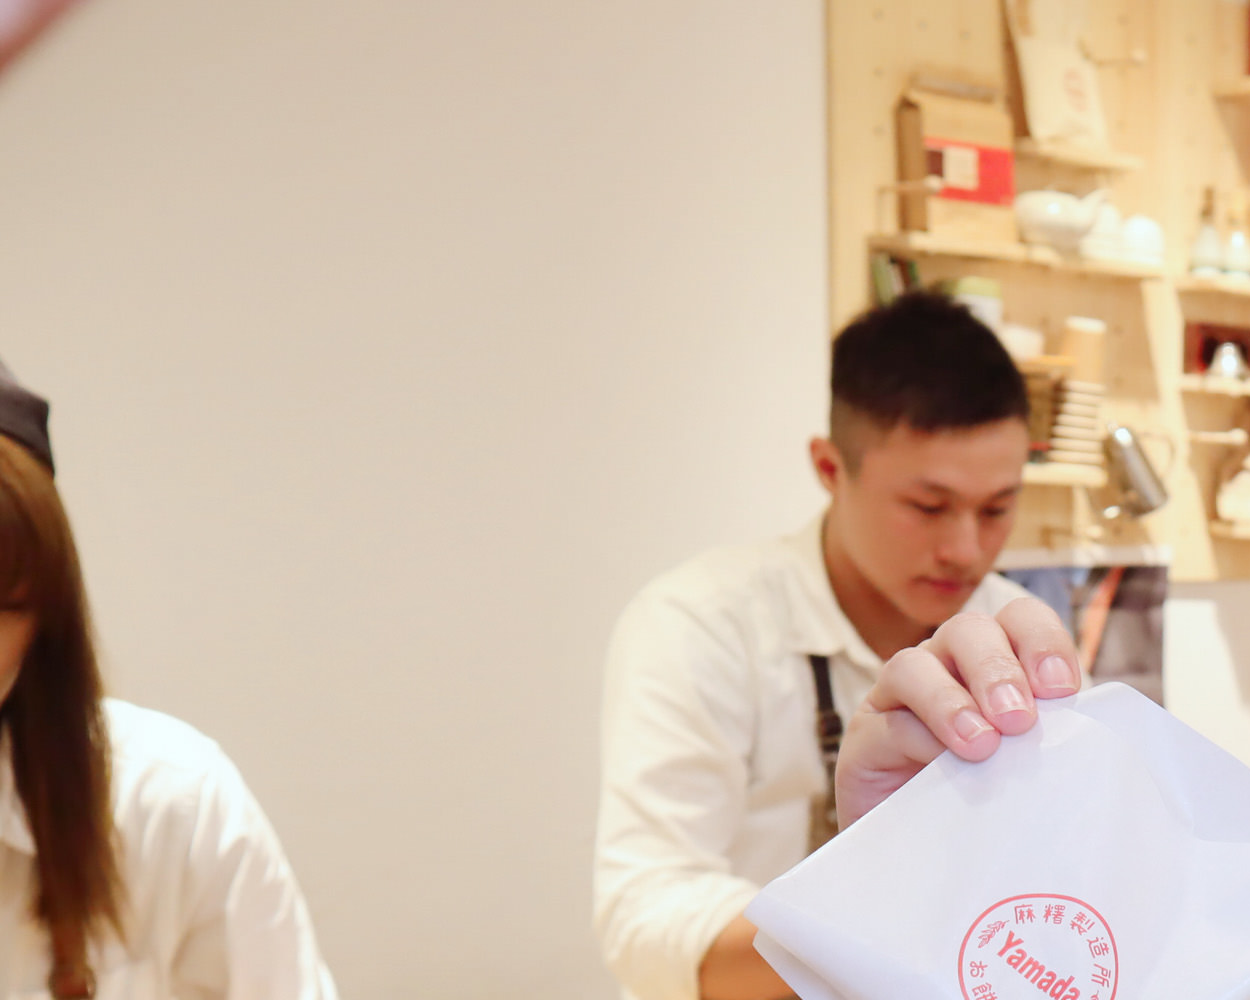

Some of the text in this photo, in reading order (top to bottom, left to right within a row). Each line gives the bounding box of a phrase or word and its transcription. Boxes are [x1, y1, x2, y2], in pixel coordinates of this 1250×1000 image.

[1013, 904, 1110, 988] 麻糬製造所
